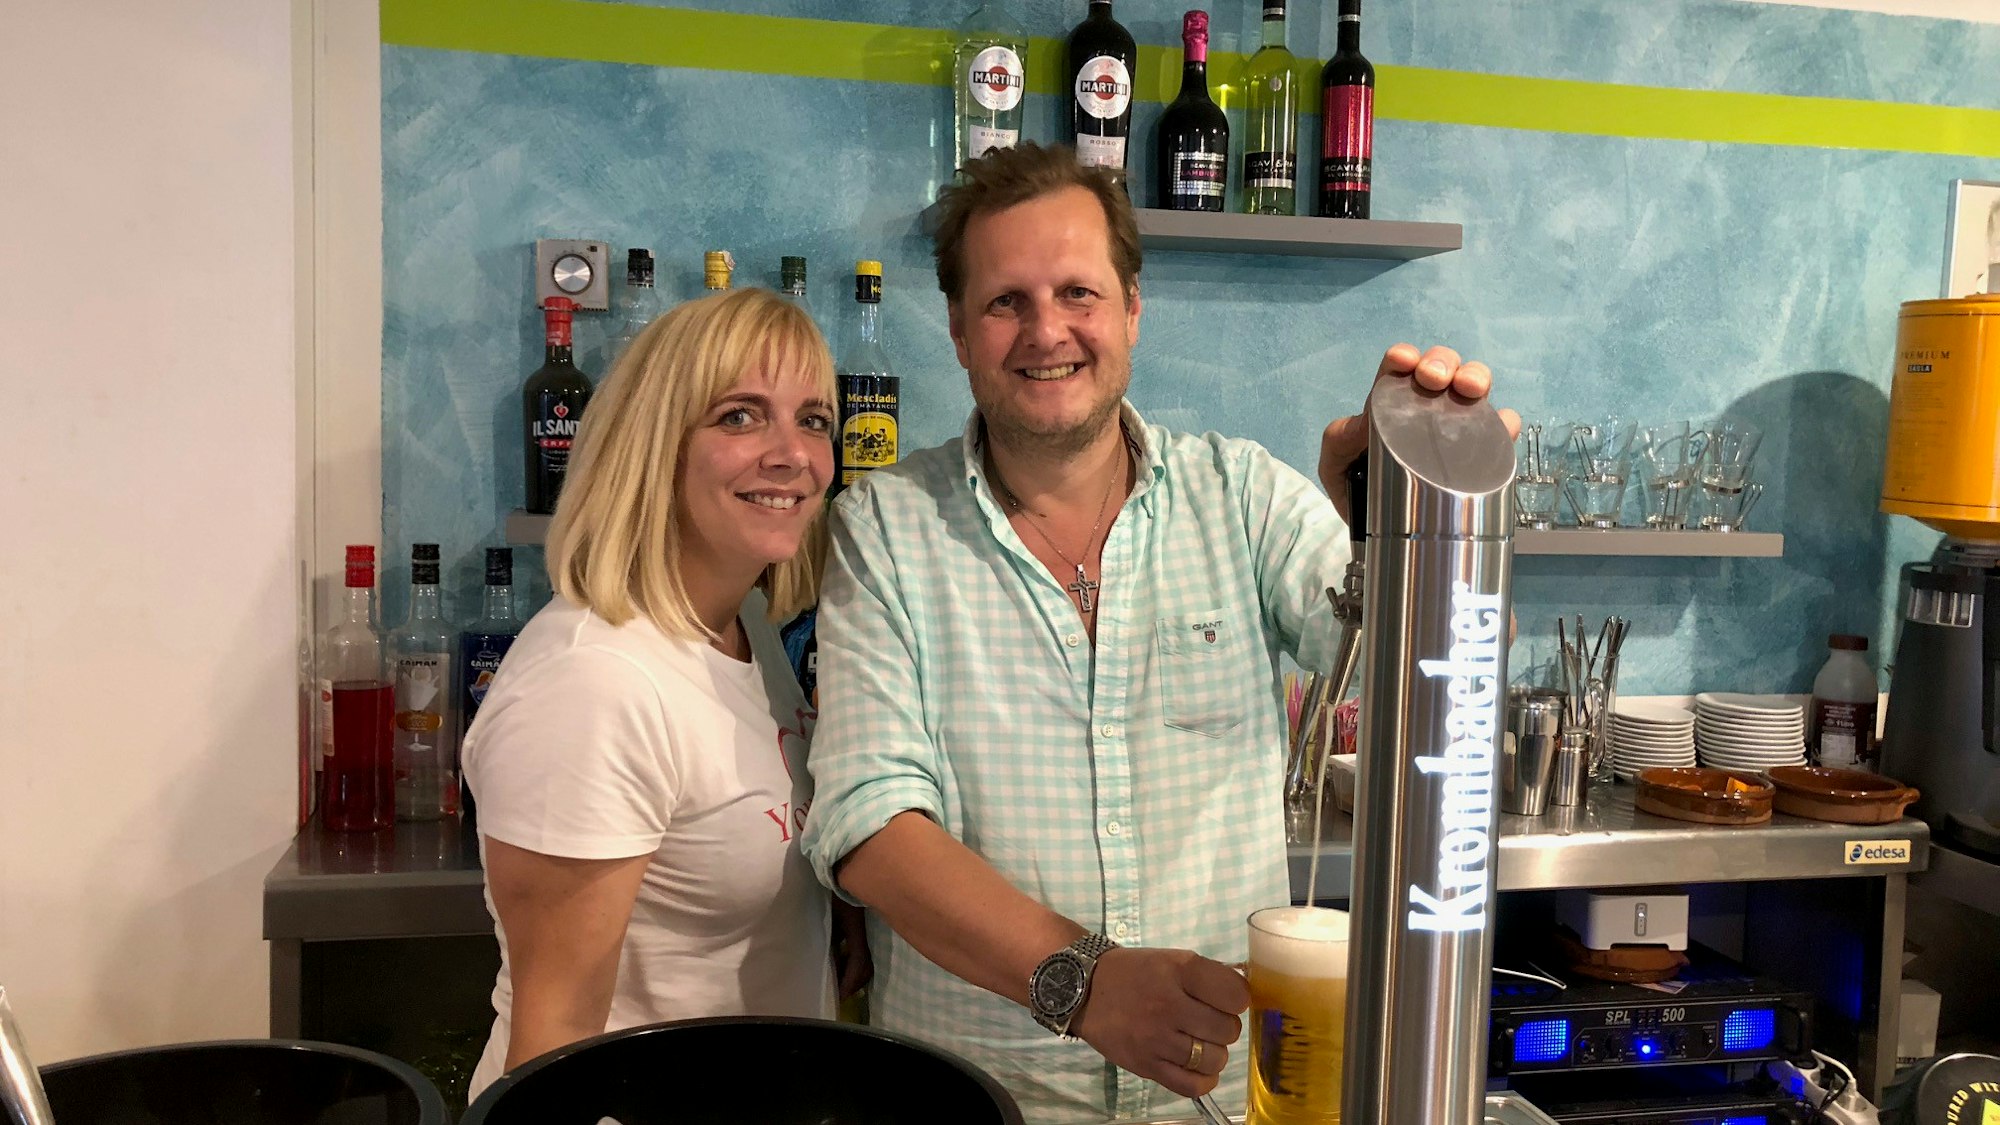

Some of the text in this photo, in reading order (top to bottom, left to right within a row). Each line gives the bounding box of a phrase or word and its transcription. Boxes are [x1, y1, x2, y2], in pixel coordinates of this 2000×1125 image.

[974, 72, 1020, 87] MARTINI
[1081, 81, 1127, 95] MARTINI
[980, 131, 1010, 139] BIANCO
[532, 420, 544, 437] IL
[1192, 620, 1223, 631] GANT
[1408, 578, 1501, 931] Krombacher
[763, 799, 813, 843] Yo
[1864, 844, 1906, 858] edesa
[1605, 1010, 1631, 1022] SPL
